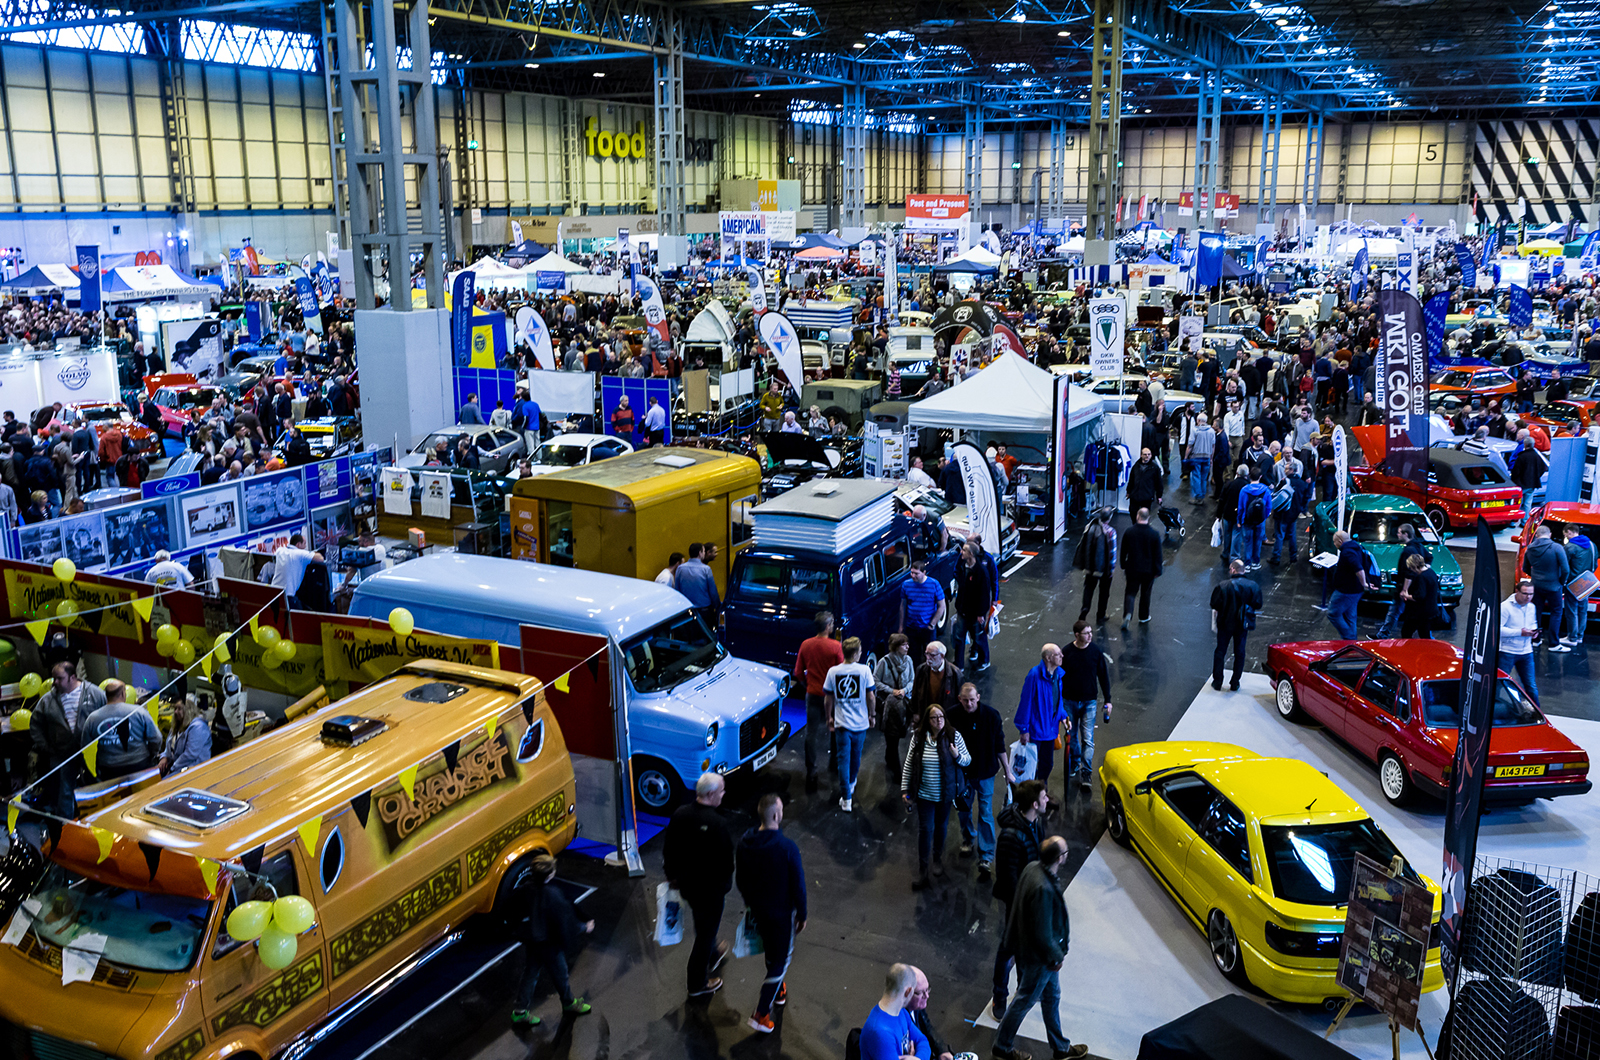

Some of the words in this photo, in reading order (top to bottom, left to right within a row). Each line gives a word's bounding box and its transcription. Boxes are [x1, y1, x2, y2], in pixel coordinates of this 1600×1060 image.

[585, 116, 645, 158] food
[1425, 144, 1437, 162] 5
[910, 199, 924, 208] Past
[926, 199, 938, 208] and
[939, 199, 965, 208] Present
[722, 219, 760, 234] AMERICAN
[60, 371, 88, 380] VOLVO
[164, 481, 181, 492] Ford
[24, 582, 69, 612] National
[343, 636, 403, 670] National
[405, 635, 449, 661] Street
[378, 729, 508, 823] ORANGE
[1500, 767, 1520, 776] A143
[1522, 766, 1540, 775] FPE
[397, 759, 507, 839] CRUSH
